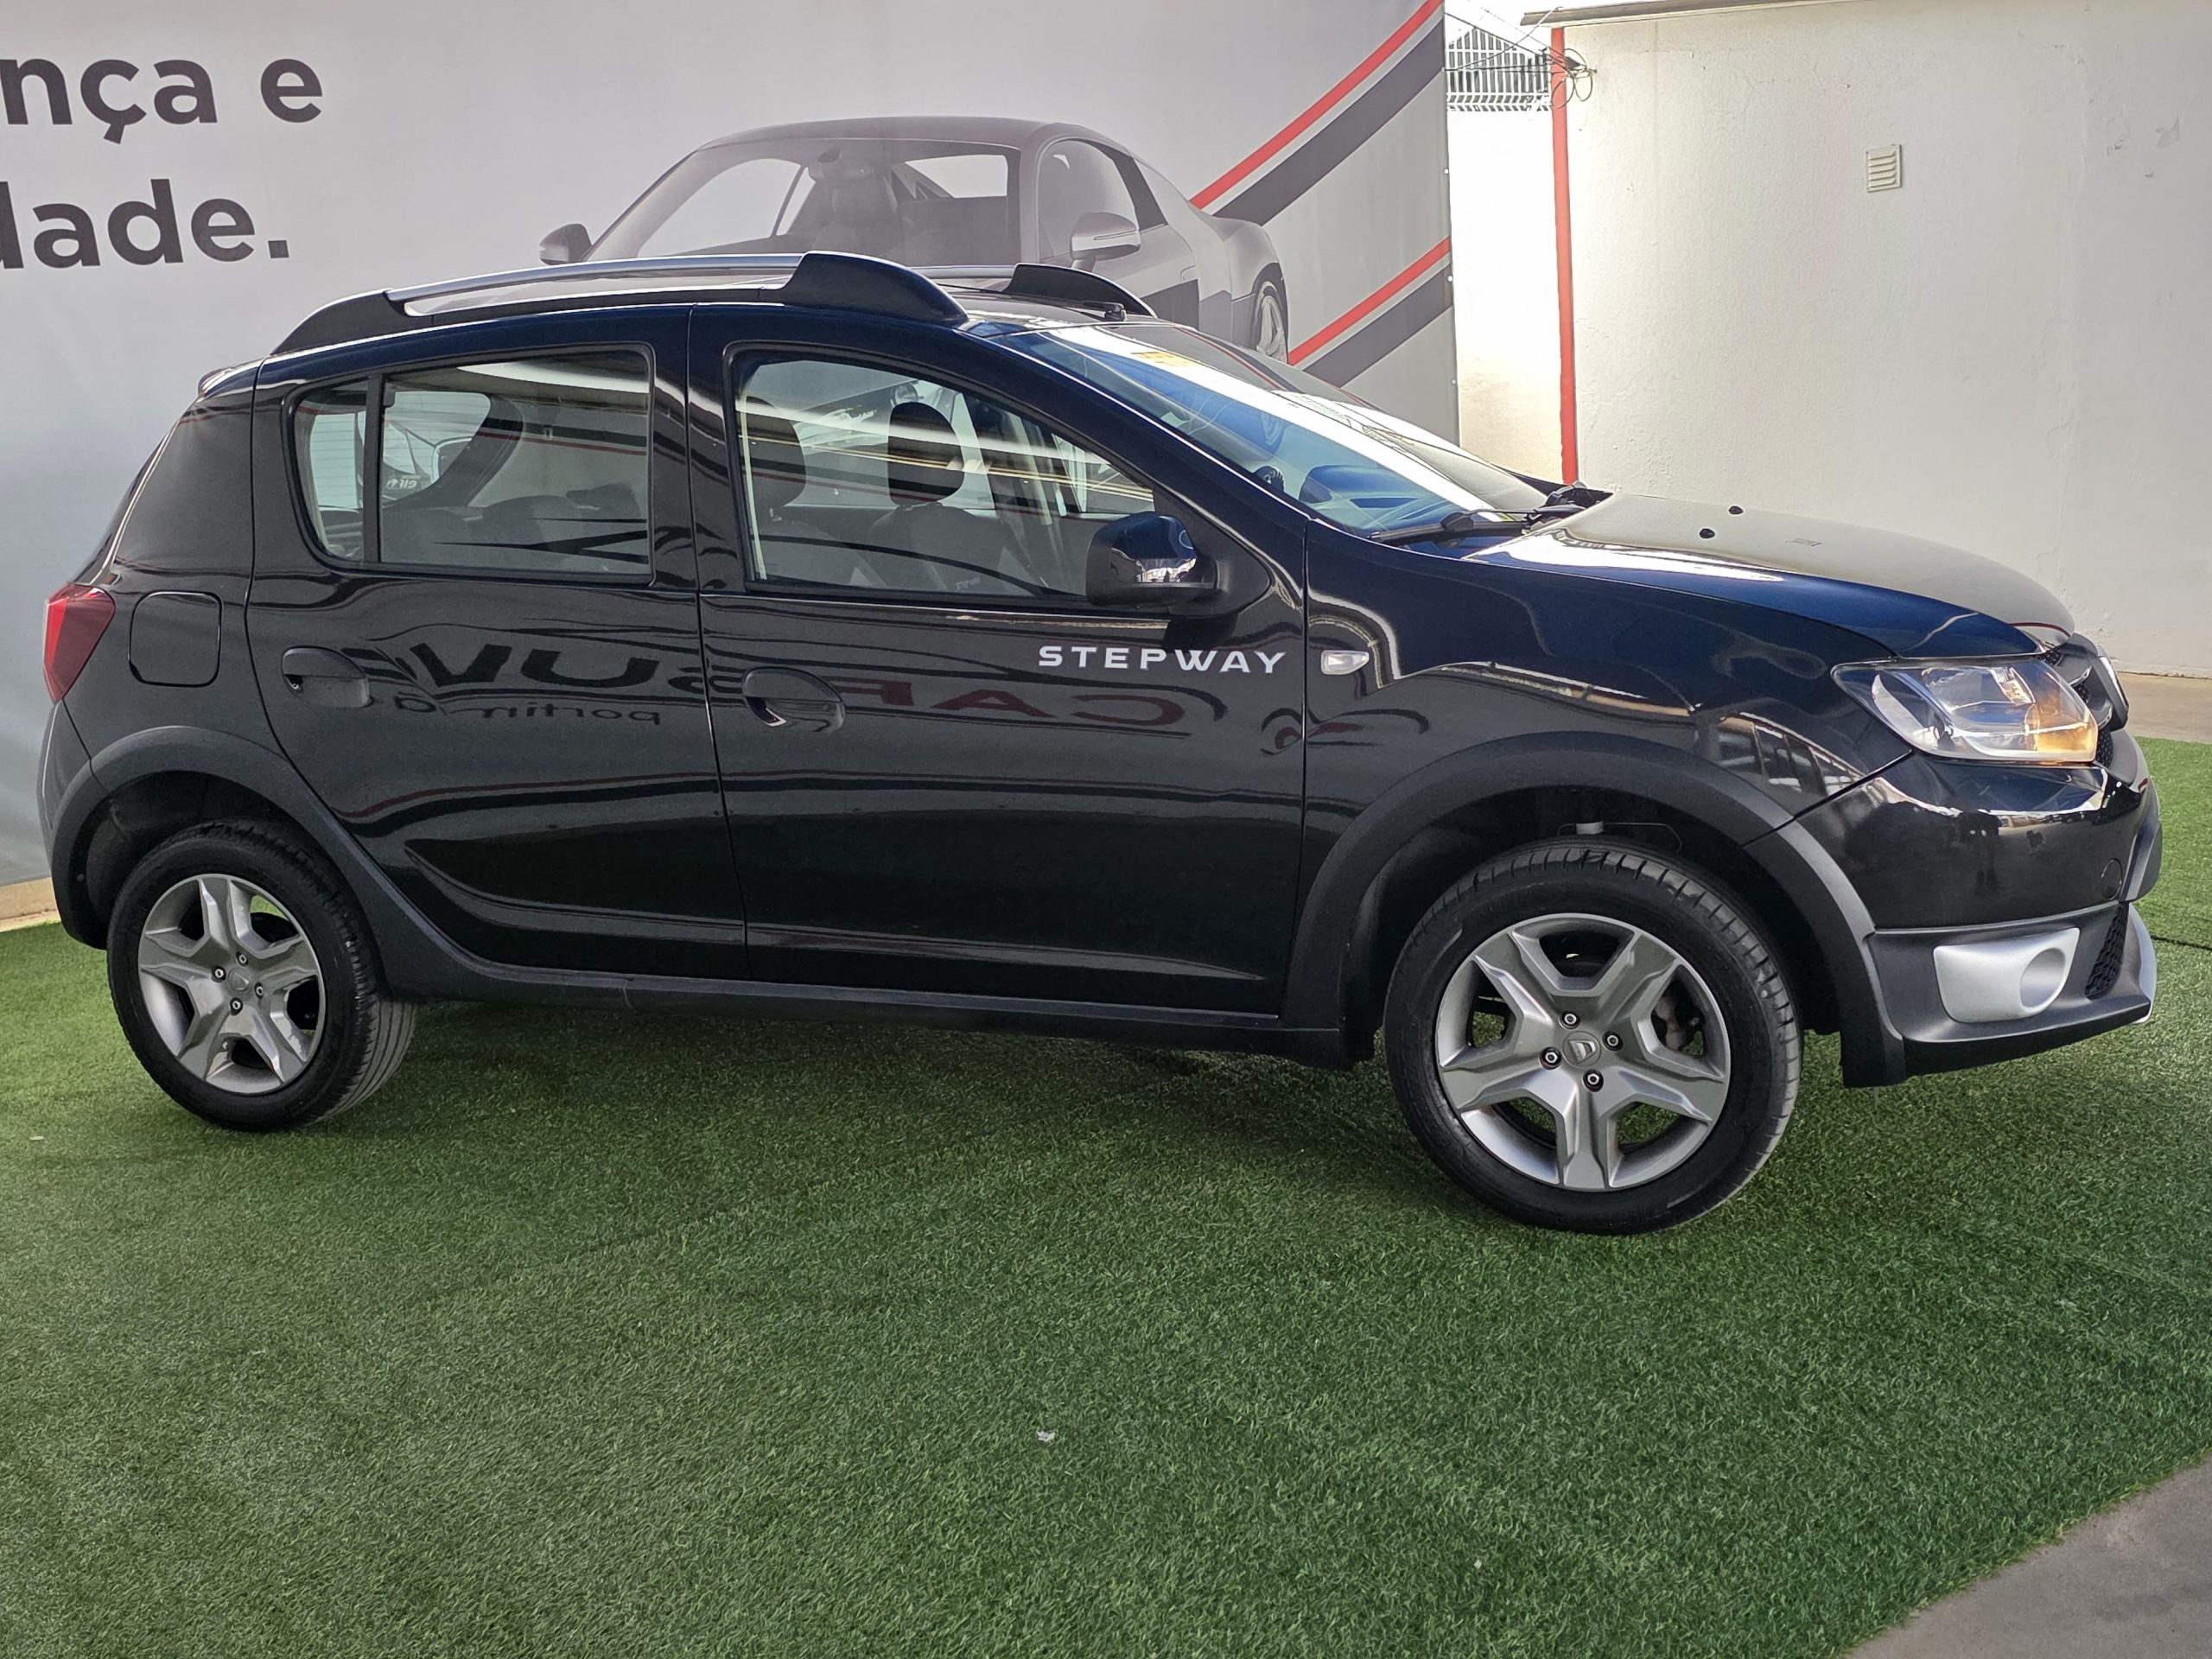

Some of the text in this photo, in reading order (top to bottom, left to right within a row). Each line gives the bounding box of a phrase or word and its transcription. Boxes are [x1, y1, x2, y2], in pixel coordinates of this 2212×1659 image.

[0, 58, 322, 143] nça e
[1039, 645, 1286, 673] STEPWAY
